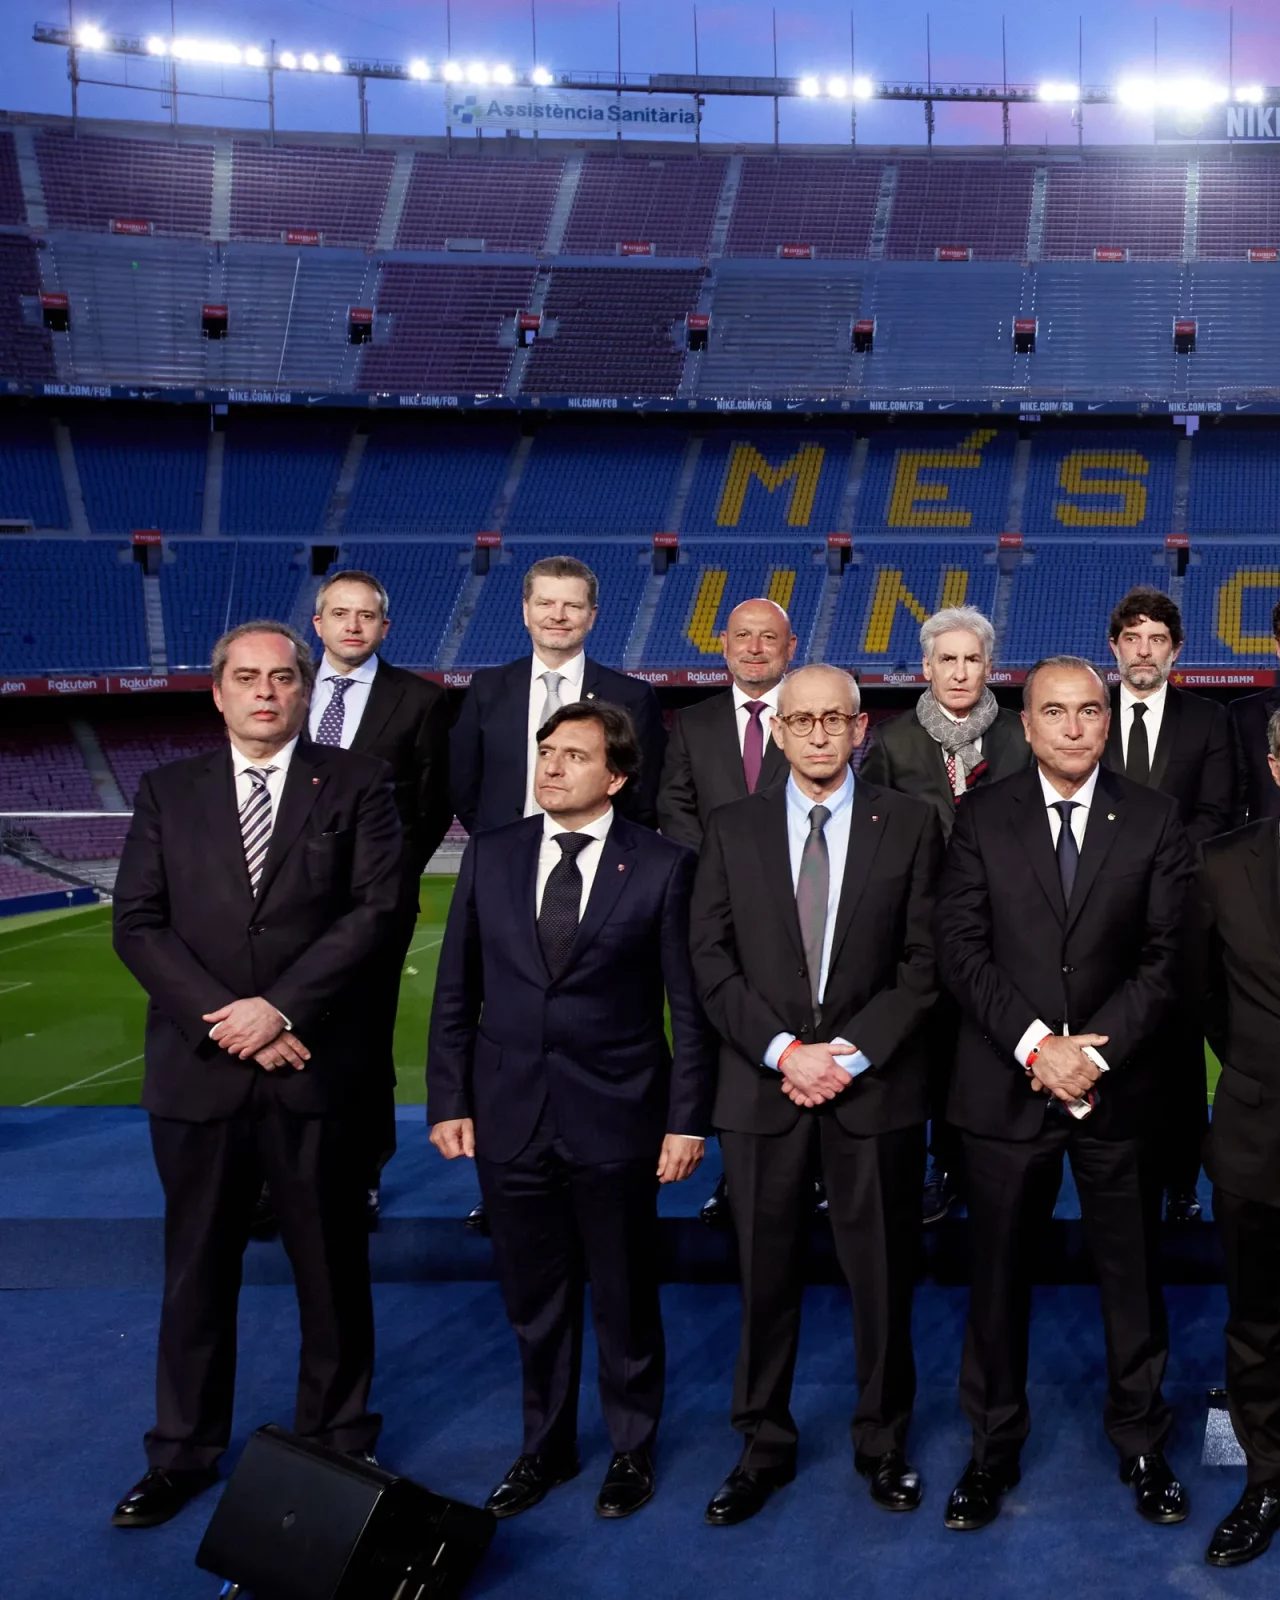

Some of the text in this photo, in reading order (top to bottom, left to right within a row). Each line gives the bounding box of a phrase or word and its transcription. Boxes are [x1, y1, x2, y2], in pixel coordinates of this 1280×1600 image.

[487, 100, 695, 124] Assistència Sanitària
[399, 396, 458, 406] NIKE.COM/FCB
[717, 401, 772, 410] NIKE.COM/FCB
[870, 401, 924, 410] NIKE.COM/FCB
[1168, 402, 1221, 411] NIKE.COM/FCB
[716, 429, 1150, 528] MÉS
[687, 570, 969, 653] UN
[687, 671, 728, 682] Rakuten
[884, 673, 916, 682] Rakuten
[1186, 675, 1254, 684] ESTRELLA DAMM
[48, 679, 97, 691] Rakuten
[120, 677, 168, 689] Rakuten
